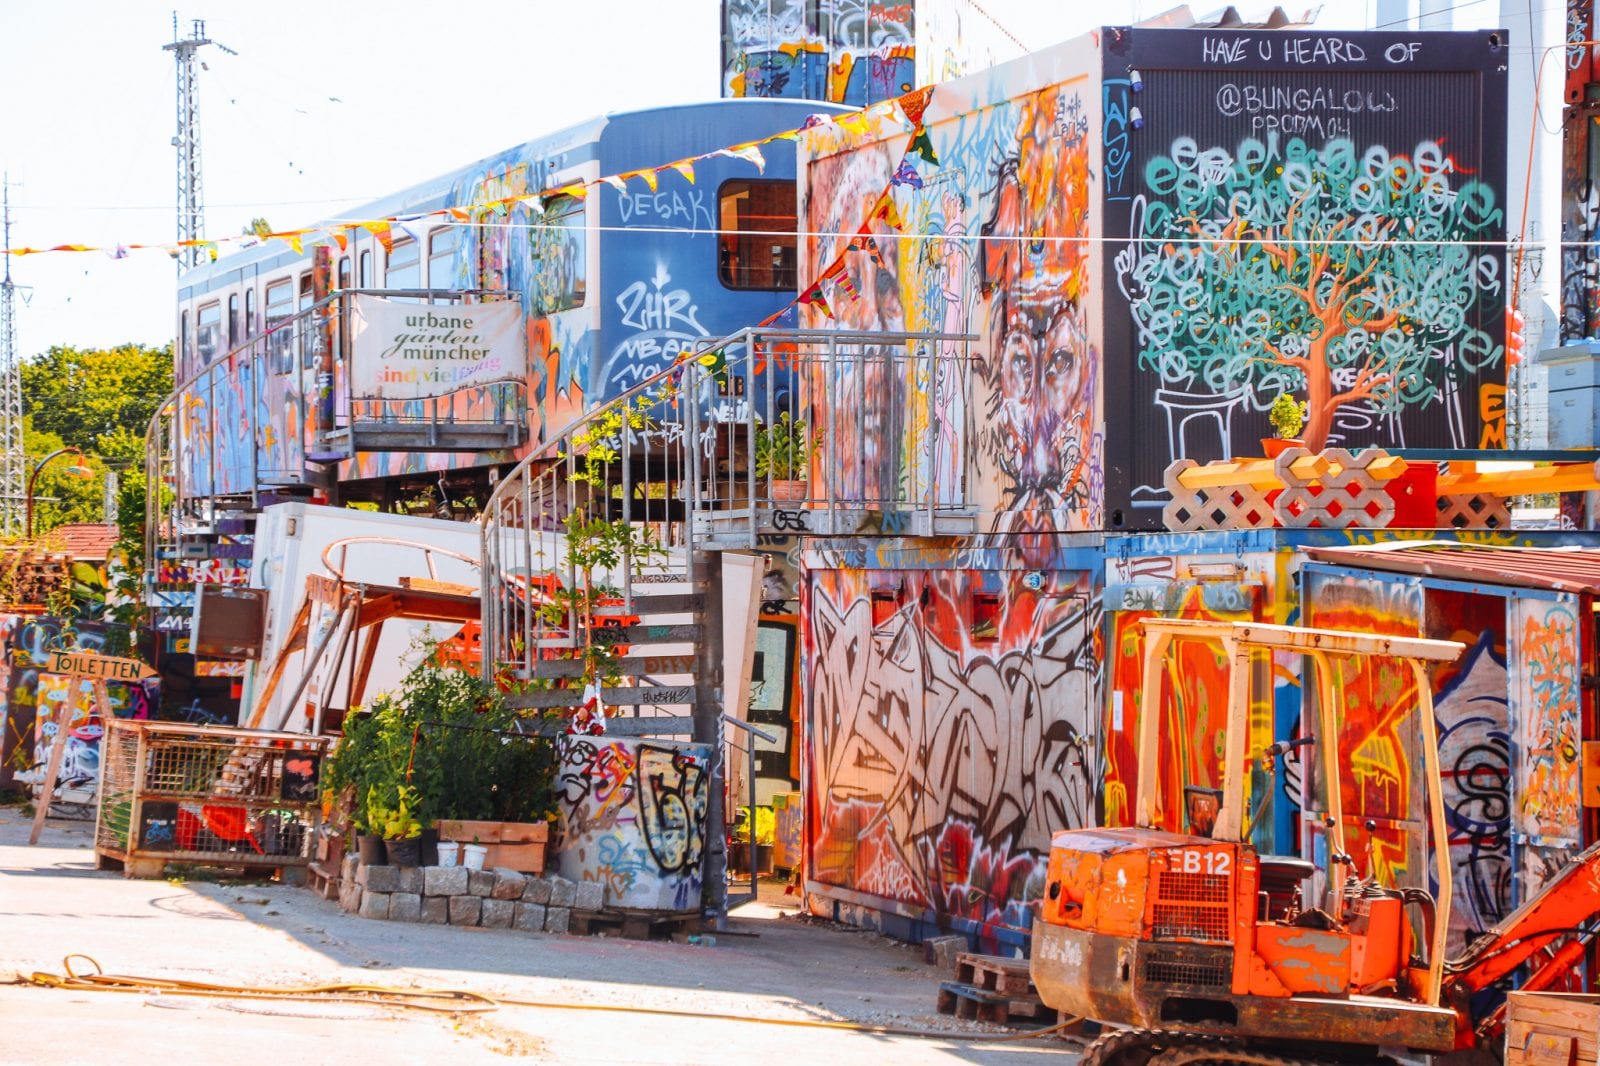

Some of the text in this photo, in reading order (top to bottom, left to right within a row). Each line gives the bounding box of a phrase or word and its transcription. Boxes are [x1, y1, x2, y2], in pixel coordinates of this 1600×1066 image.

[1203, 37, 1423, 64] HAVE U HEARD OF
[406, 311, 474, 329] urbane
[381, 326, 479, 359] gärten
[376, 365, 417, 383] sind
[52, 651, 141, 678] TOILETTEN
